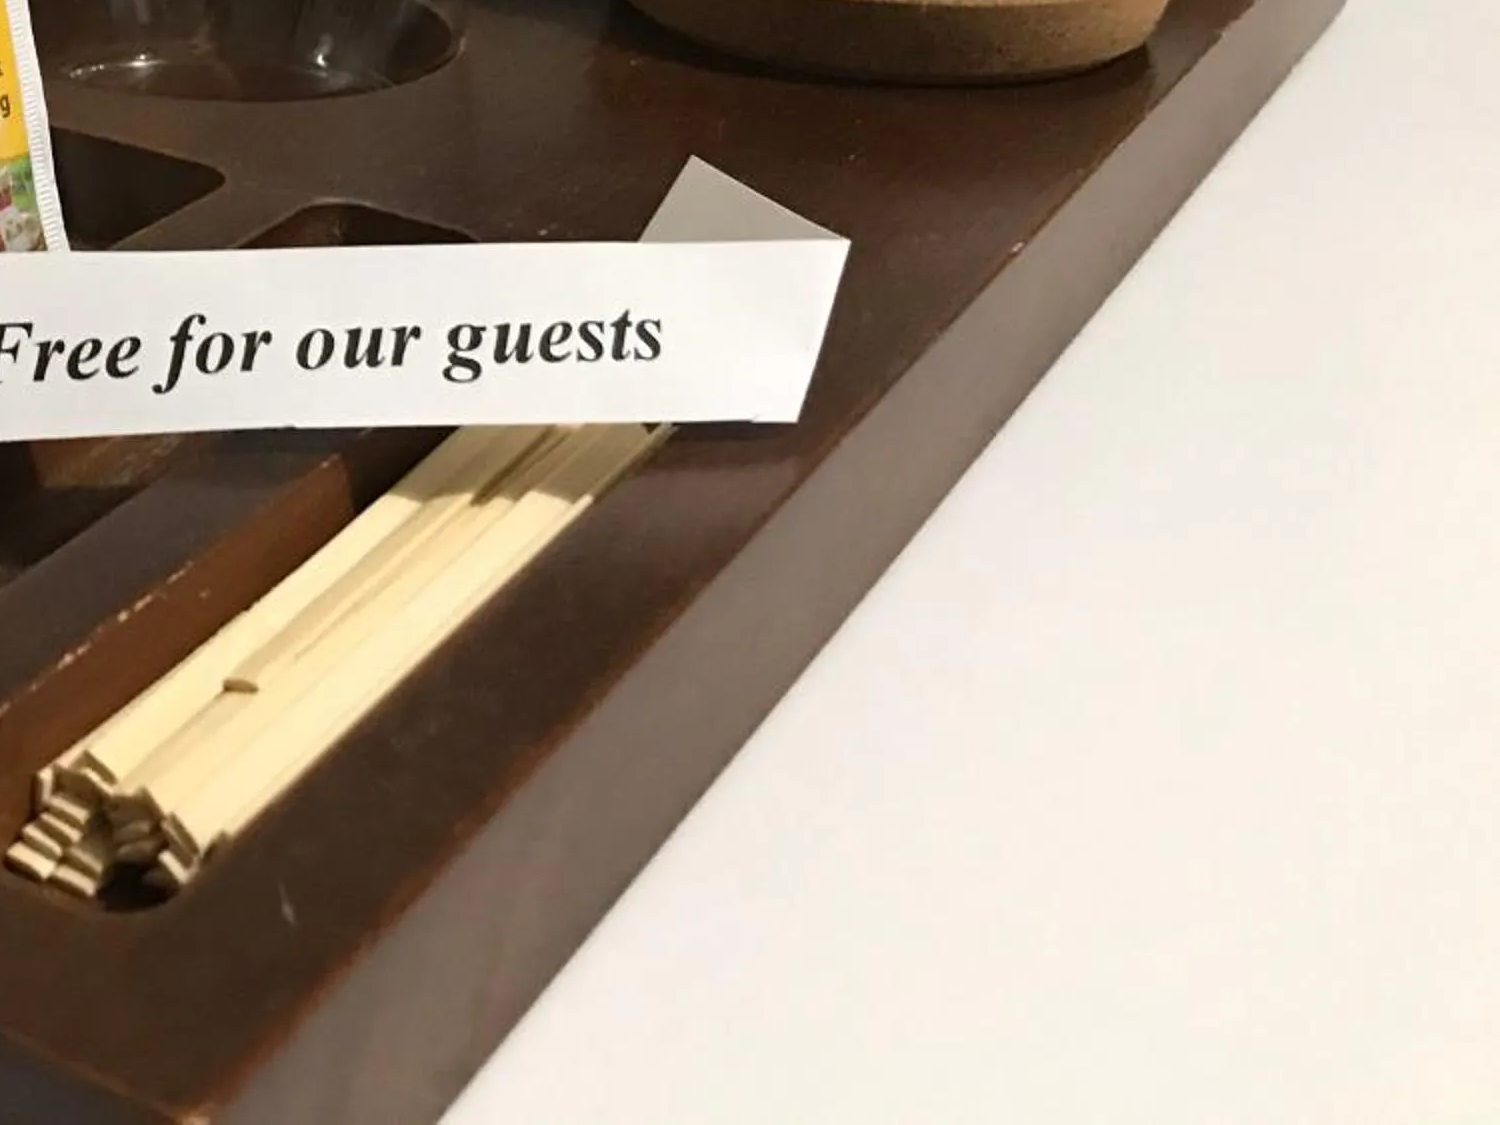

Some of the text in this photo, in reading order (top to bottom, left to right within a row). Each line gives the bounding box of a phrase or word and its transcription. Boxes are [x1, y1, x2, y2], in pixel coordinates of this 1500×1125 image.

[0, 93, 12, 120] g
[151, 313, 274, 396] for
[294, 322, 422, 372] our
[441, 308, 665, 386] guests
